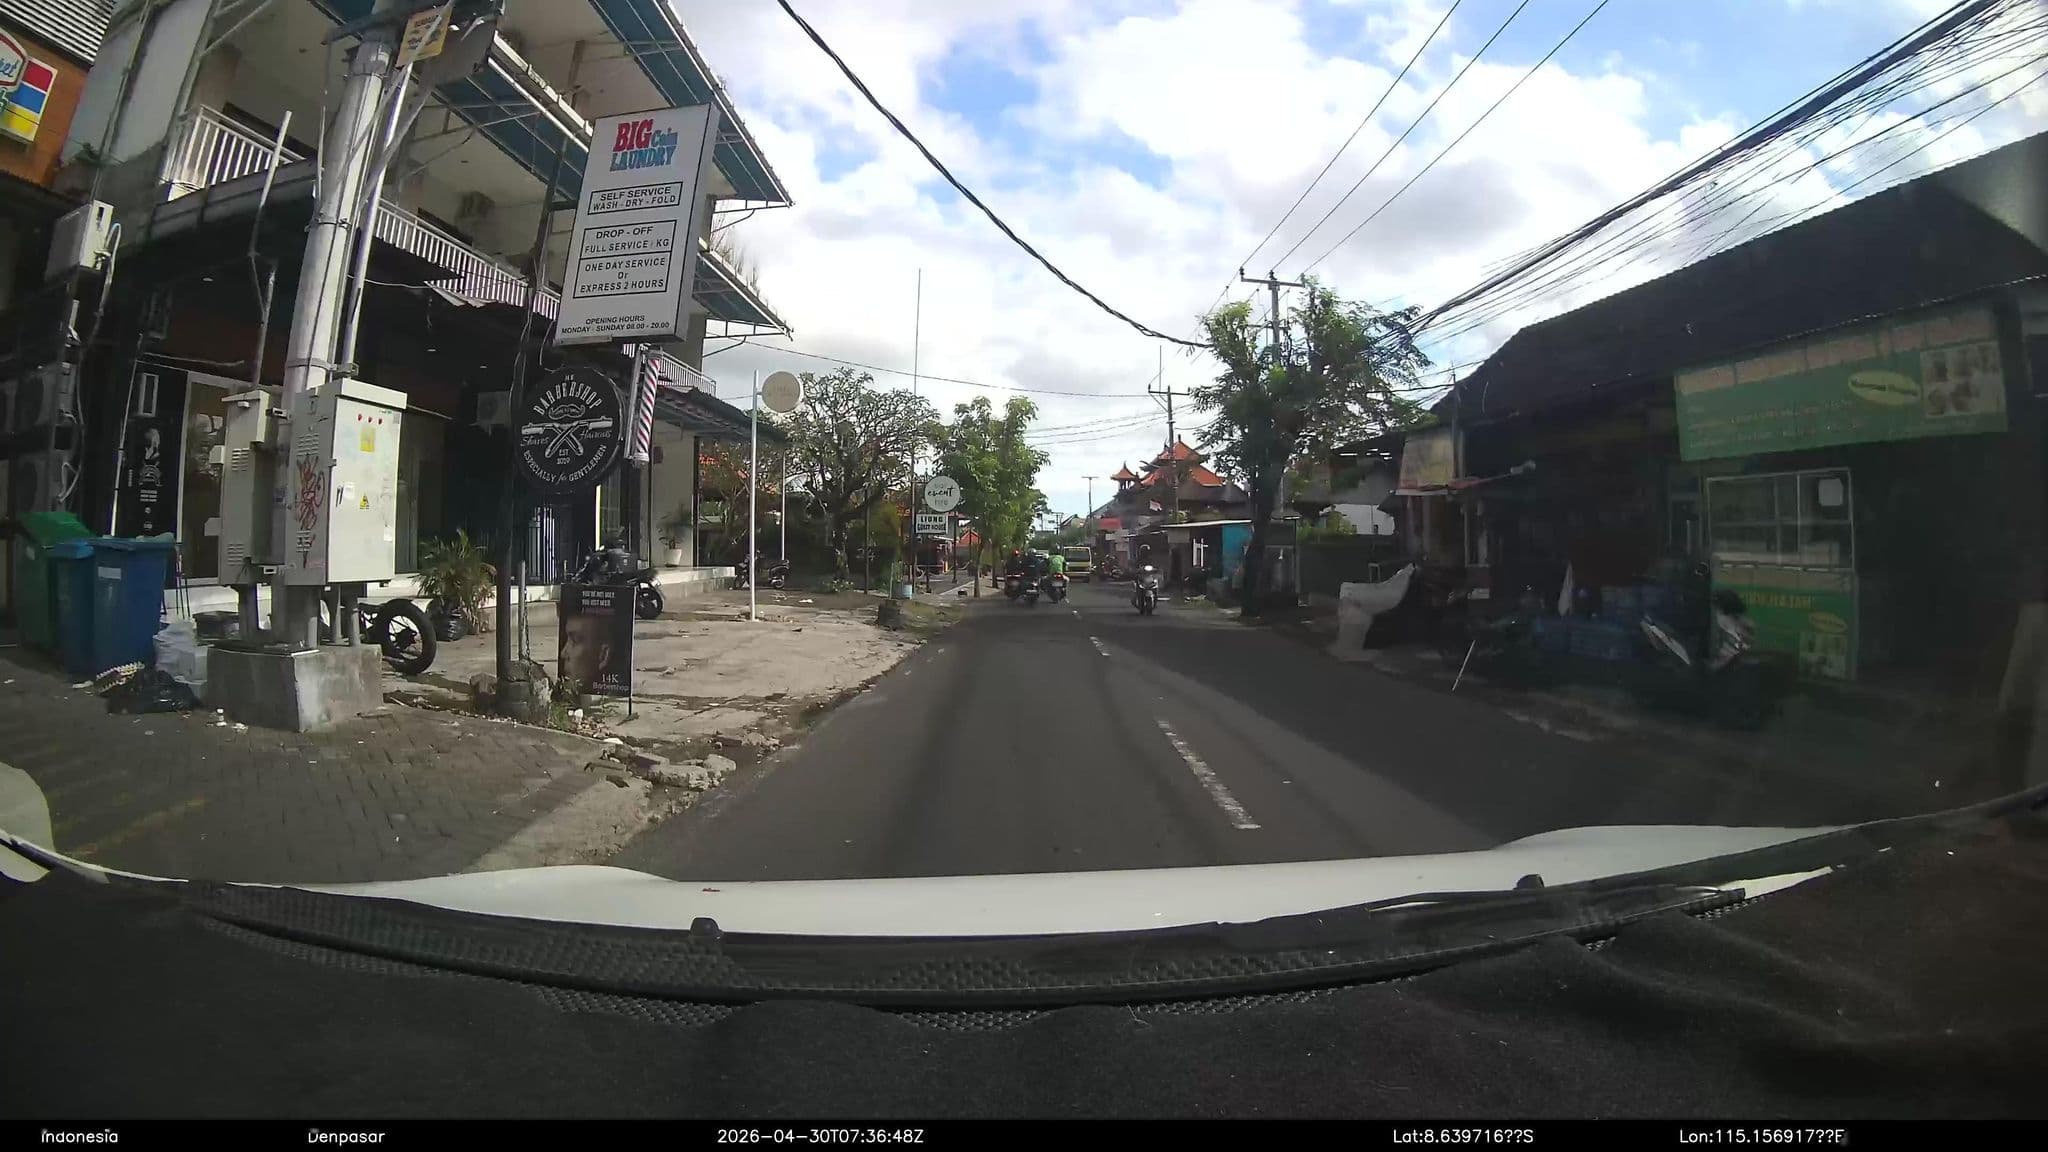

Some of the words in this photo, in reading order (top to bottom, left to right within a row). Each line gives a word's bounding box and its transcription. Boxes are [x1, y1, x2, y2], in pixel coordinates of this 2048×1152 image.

[612, 119, 654, 152] BIG
[651, 127, 678, 148] Coin
[609, 146, 677, 172] LAUNDRY
[600, 191, 625, 201] SELF
[627, 186, 671, 198] SERVICE
[593, 201, 618, 211] WASH
[625, 198, 643, 208] DRY
[651, 195, 676, 205] FOLD
[596, 229, 625, 239] DROP
[632, 226, 654, 236] OFF
[585, 245, 606, 253] FULL
[608, 240, 649, 252] SERVICE
[656, 238, 669, 247] KG
[585, 262, 603, 272] ONE
[605, 261, 624, 270] DAY
[625, 257, 665, 268] SERVICE
[618, 271, 628, 279] Or
[580, 282, 622, 292] EXPRESS
[624, 281, 629, 289] 2
[631, 279, 664, 289] HOURS
[585, 317, 617, 325] OPENING
[619, 315, 645, 323] HOURS
[561, 326, 591, 334] MONDAY
[596, 324, 625, 332] SUNDAY
[533, 381, 603, 415] BARBERSHOP
[523, 449, 557, 483] ESPECIALLY
[568, 444, 607, 482] GENTLEMEN
[601, 673, 619, 683] 14K
